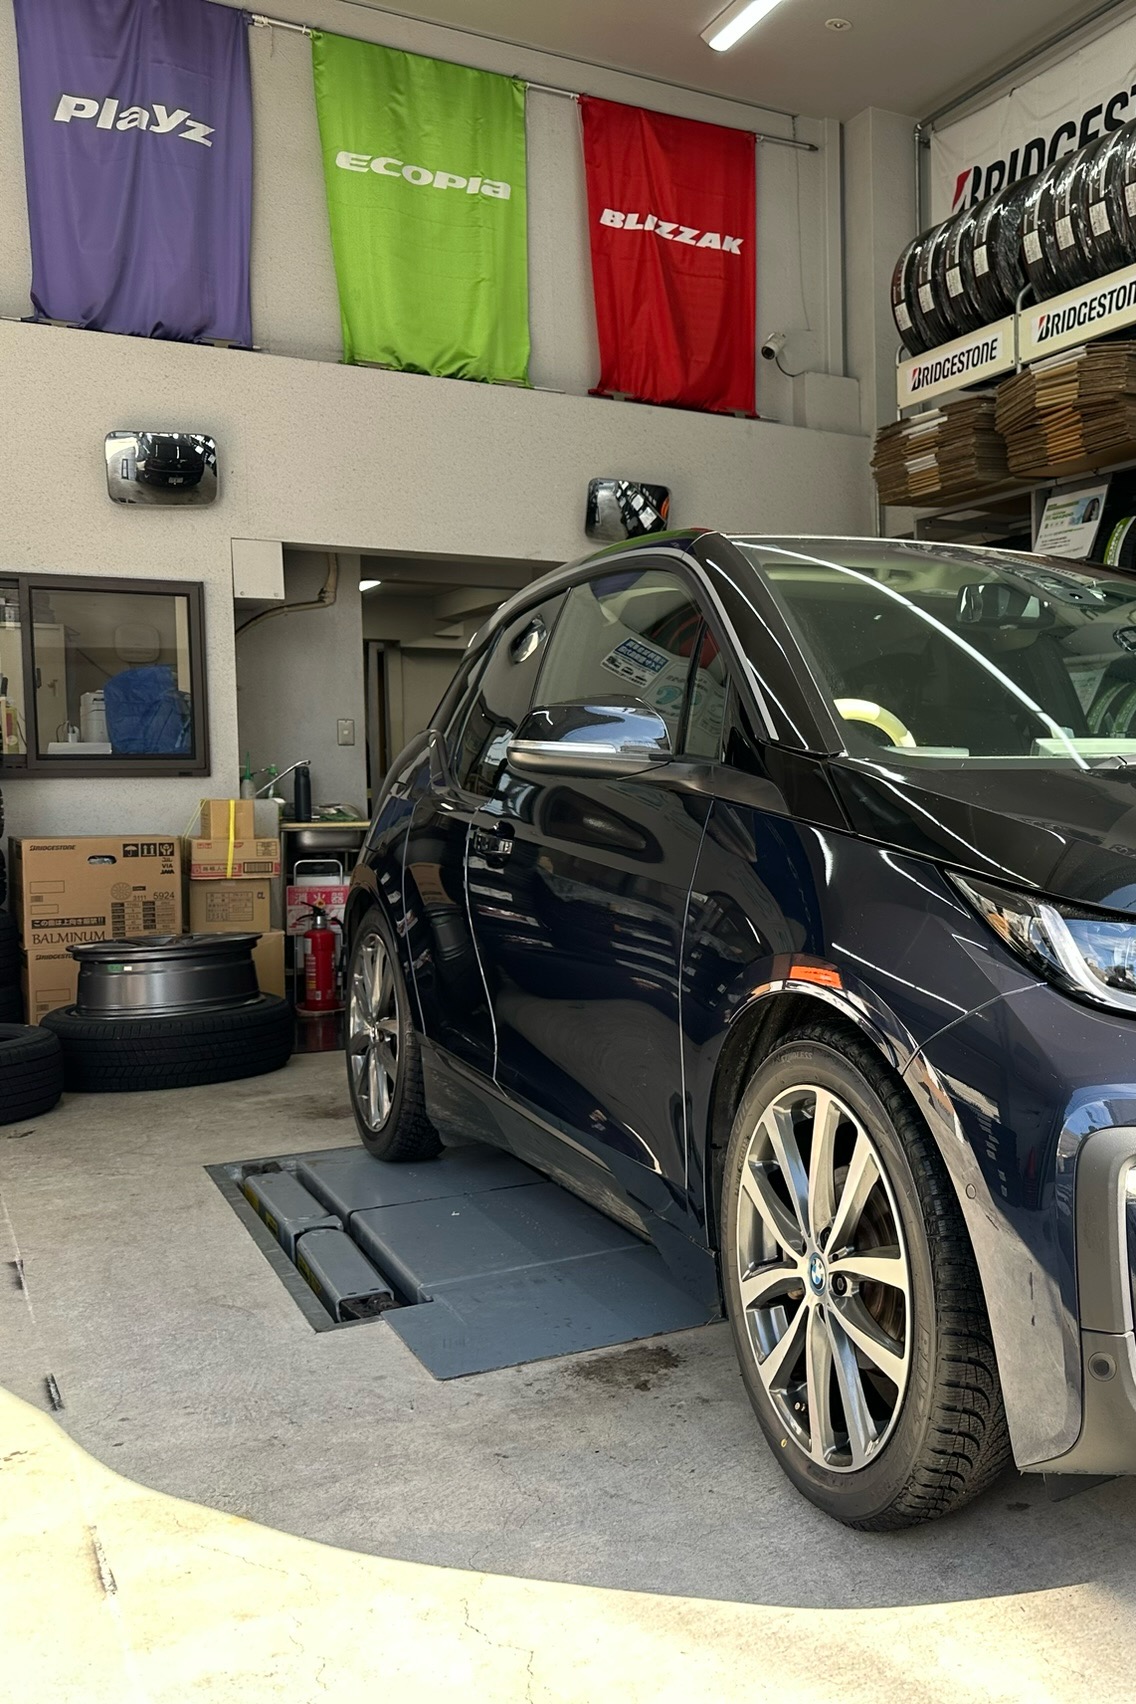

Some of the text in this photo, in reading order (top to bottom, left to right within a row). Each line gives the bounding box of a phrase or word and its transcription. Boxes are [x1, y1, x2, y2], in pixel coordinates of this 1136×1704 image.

[600, 207, 744, 256] BLIZZAK
[910, 338, 998, 392] BRIDGESTONE
[153, 891, 175, 900] 5924
[294, 892, 345, 906] 消火器
[31, 931, 106, 945] BALMINUM
